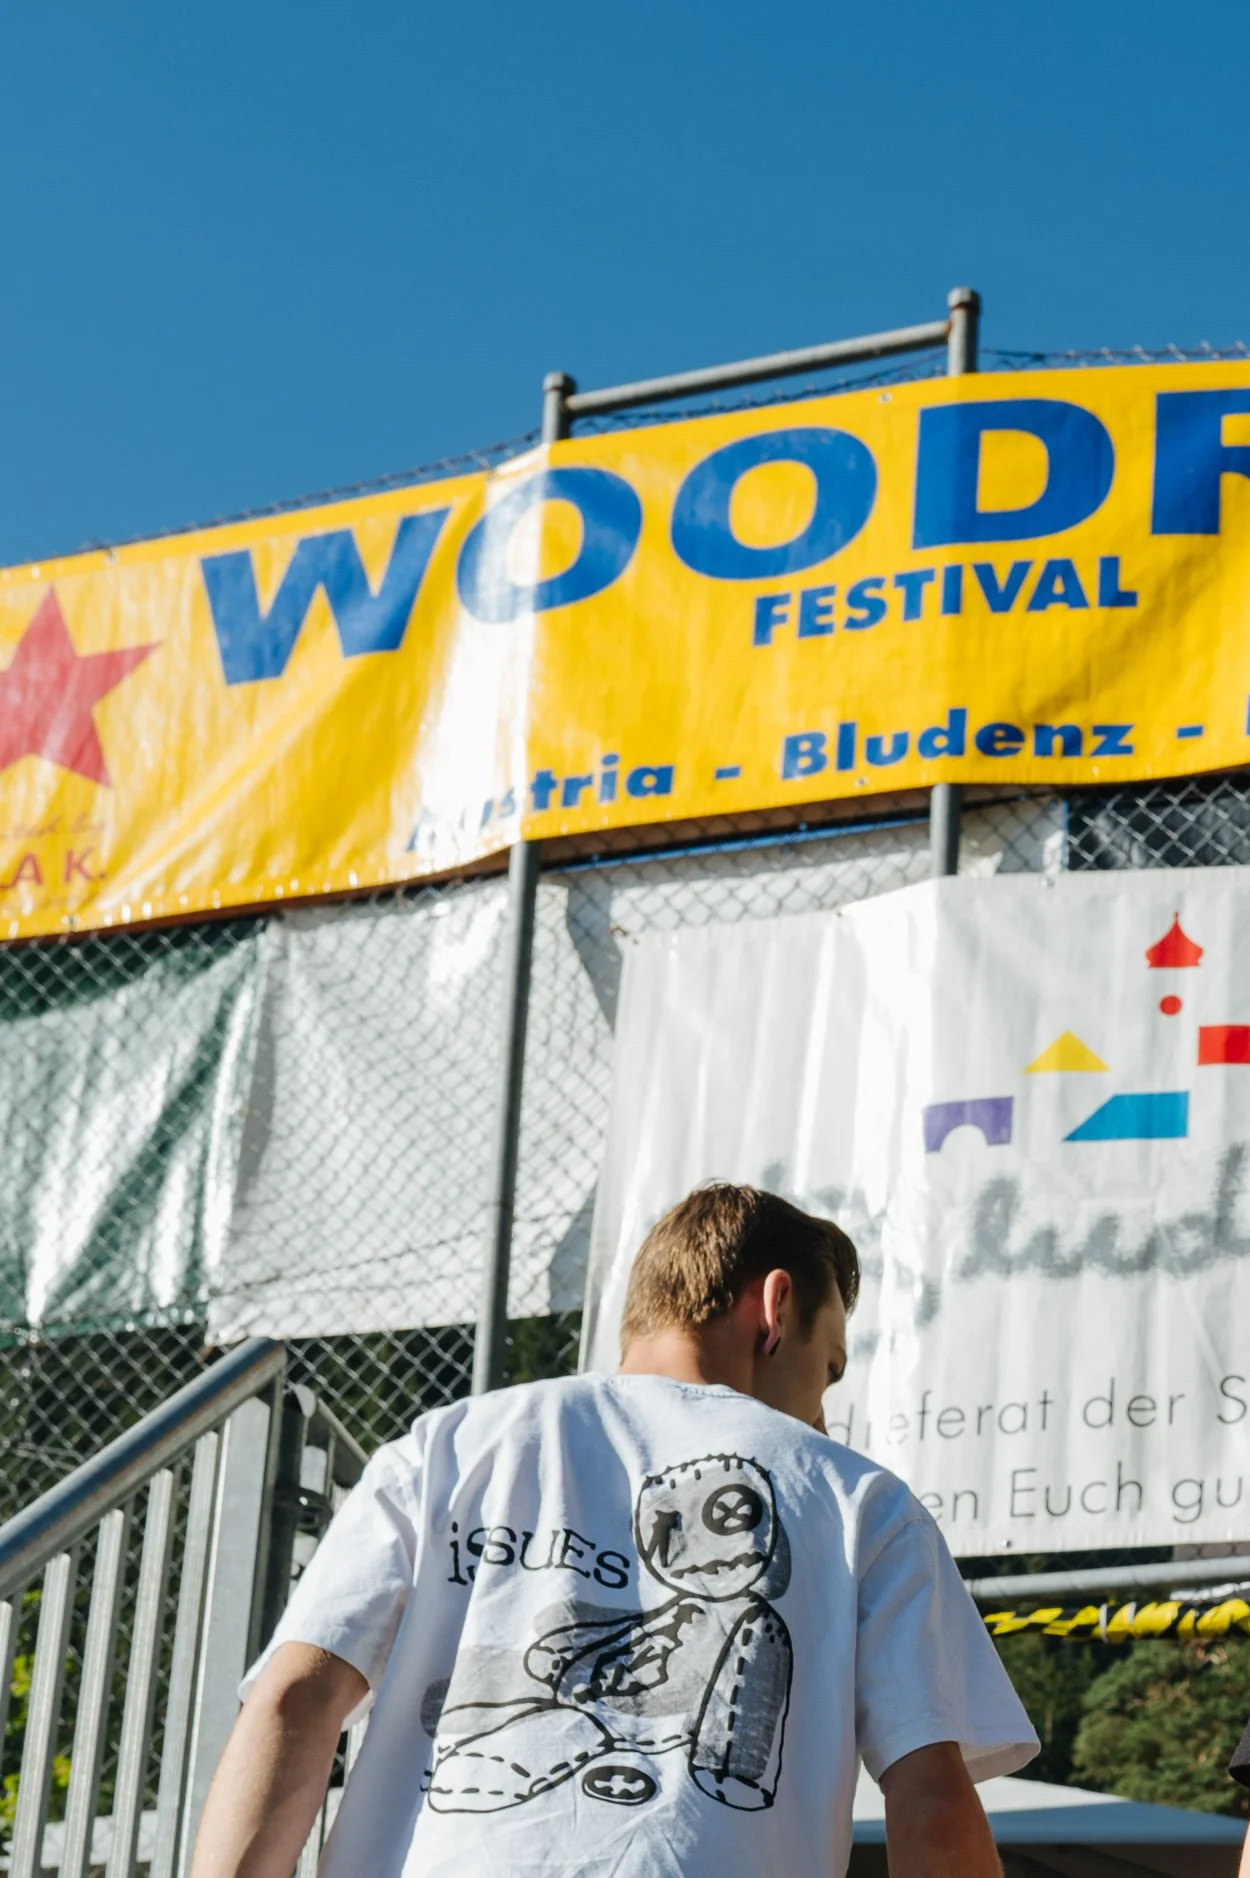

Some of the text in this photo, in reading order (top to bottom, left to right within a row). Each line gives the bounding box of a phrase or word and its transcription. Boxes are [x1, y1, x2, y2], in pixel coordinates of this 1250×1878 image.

[752, 555, 1139, 646] FESTIVAL
[781, 707, 1135, 780] Bludenz
[1083, 1377, 1185, 1428] der
[1011, 1461, 1144, 1519] Euch
